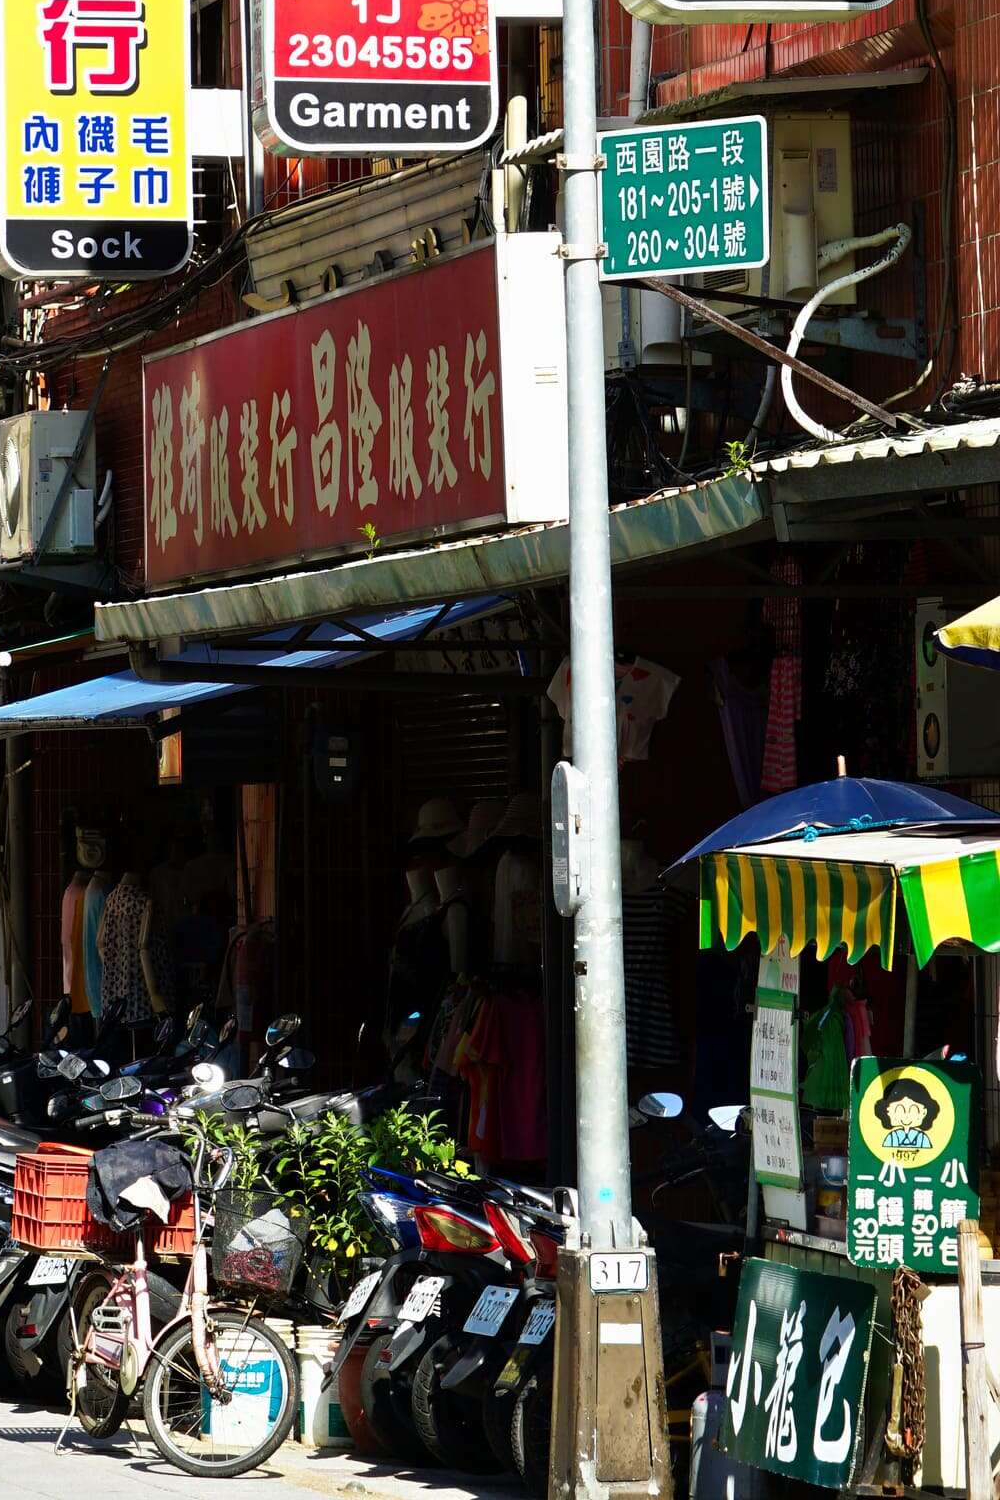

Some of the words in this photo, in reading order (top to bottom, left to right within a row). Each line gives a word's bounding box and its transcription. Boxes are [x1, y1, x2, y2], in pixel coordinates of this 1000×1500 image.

[288, 34, 474, 70] 23045585
[289, 94, 472, 130] Garment
[615, 130, 744, 176] 西園路一段
[51, 229, 142, 259] Sock
[877, 1159, 906, 1266] 小饅頭
[596, 1260, 641, 1285] 317
[726, 1299, 856, 1464] 小籠包
